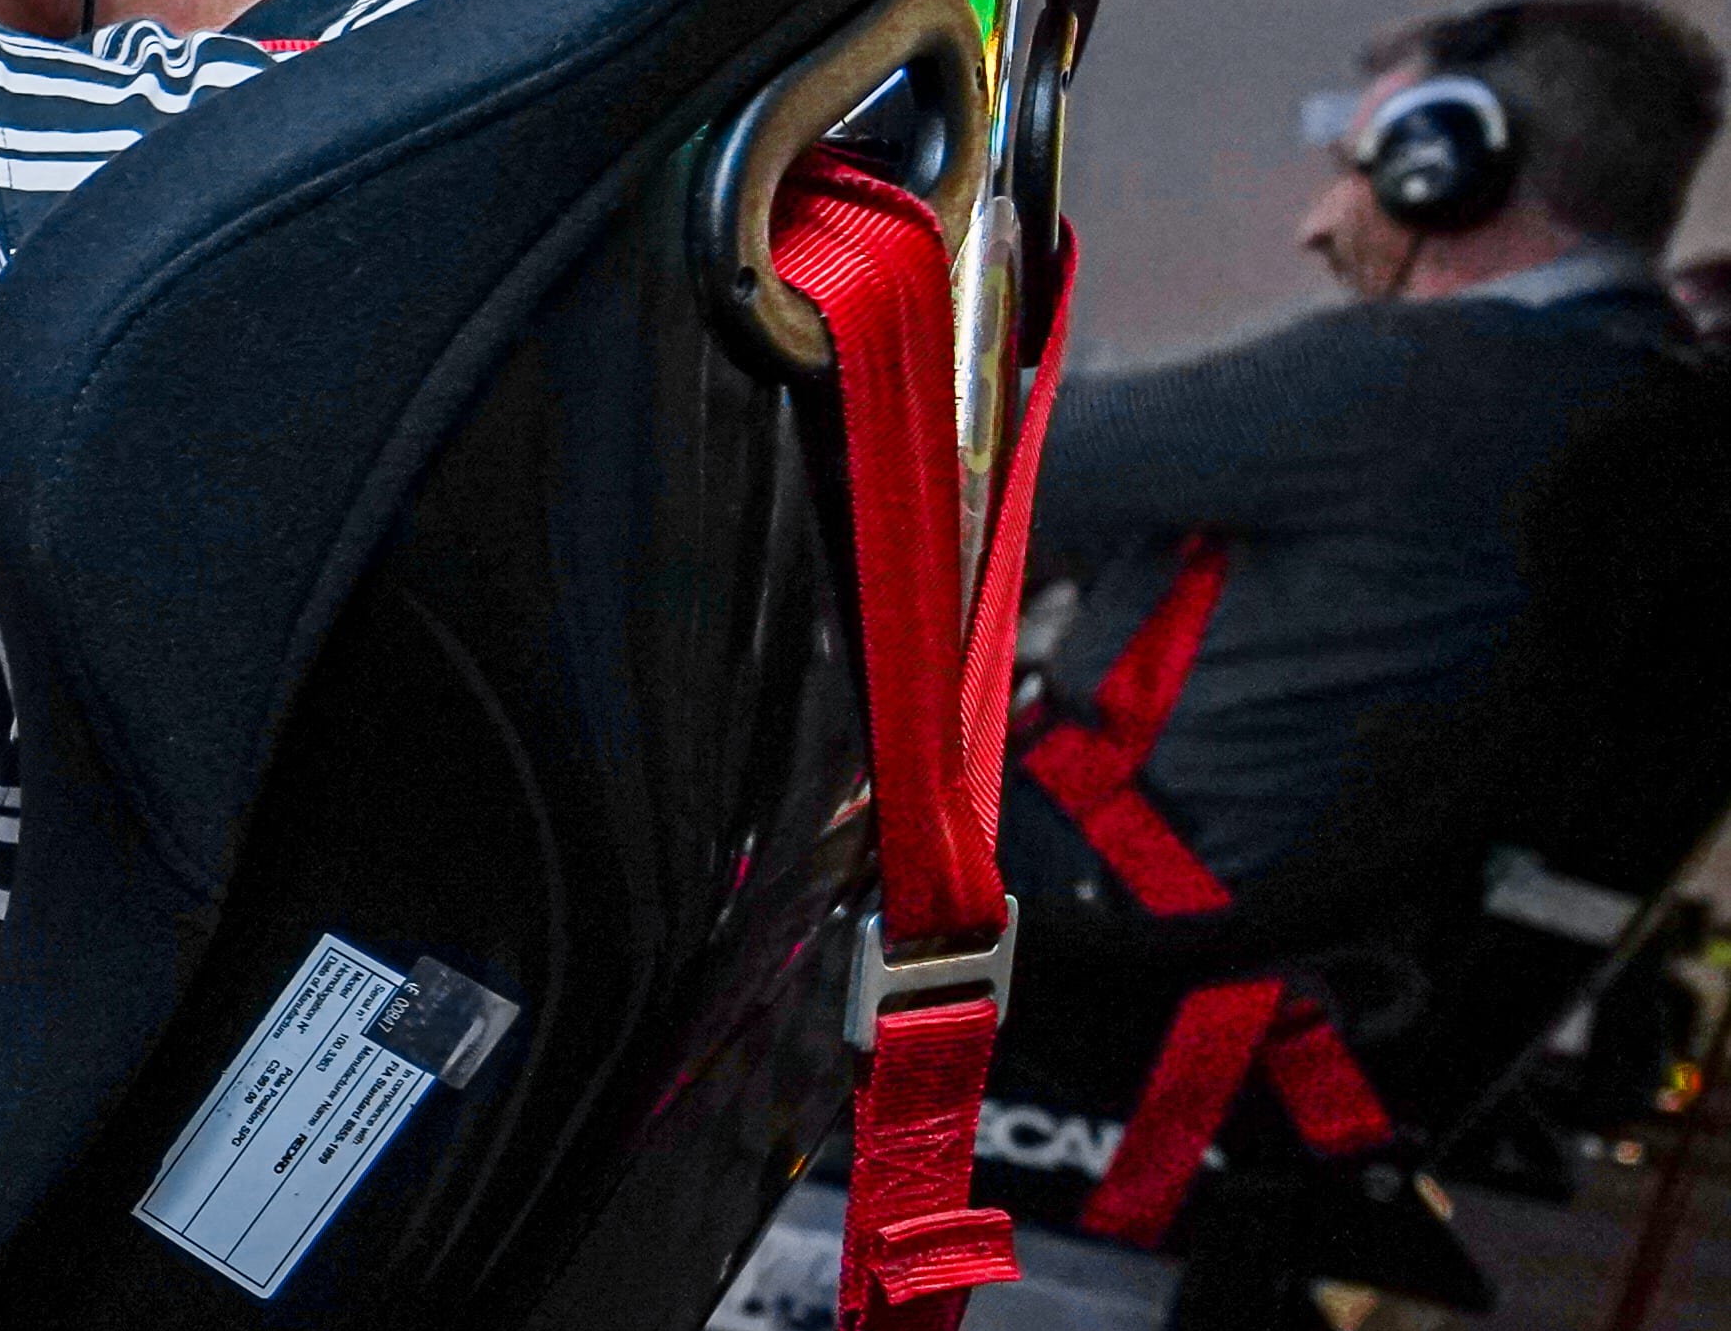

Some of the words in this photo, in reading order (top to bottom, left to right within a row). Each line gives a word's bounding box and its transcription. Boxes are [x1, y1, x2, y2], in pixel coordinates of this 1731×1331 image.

[318, 955, 339, 977] Date
[304, 962, 353, 1021] Homologation
[310, 976, 321, 988] of
[339, 970, 365, 999] Model
[362, 984, 386, 1011] Serial
[272, 987, 315, 1039] Manufacture
[273, 1067, 294, 1088] Pole
[327, 1045, 374, 1102] Manufacturer
[381, 1060, 400, 1077] FIA
[402, 1069, 415, 1079] In
[246, 1088, 279, 1125] Position
[351, 1077, 387, 1120] Standard
[366, 1079, 405, 1127] compliance
[308, 1100, 333, 1127] Name
[231, 1125, 251, 1147] SPG
[273, 1133, 308, 1174] RECARO
